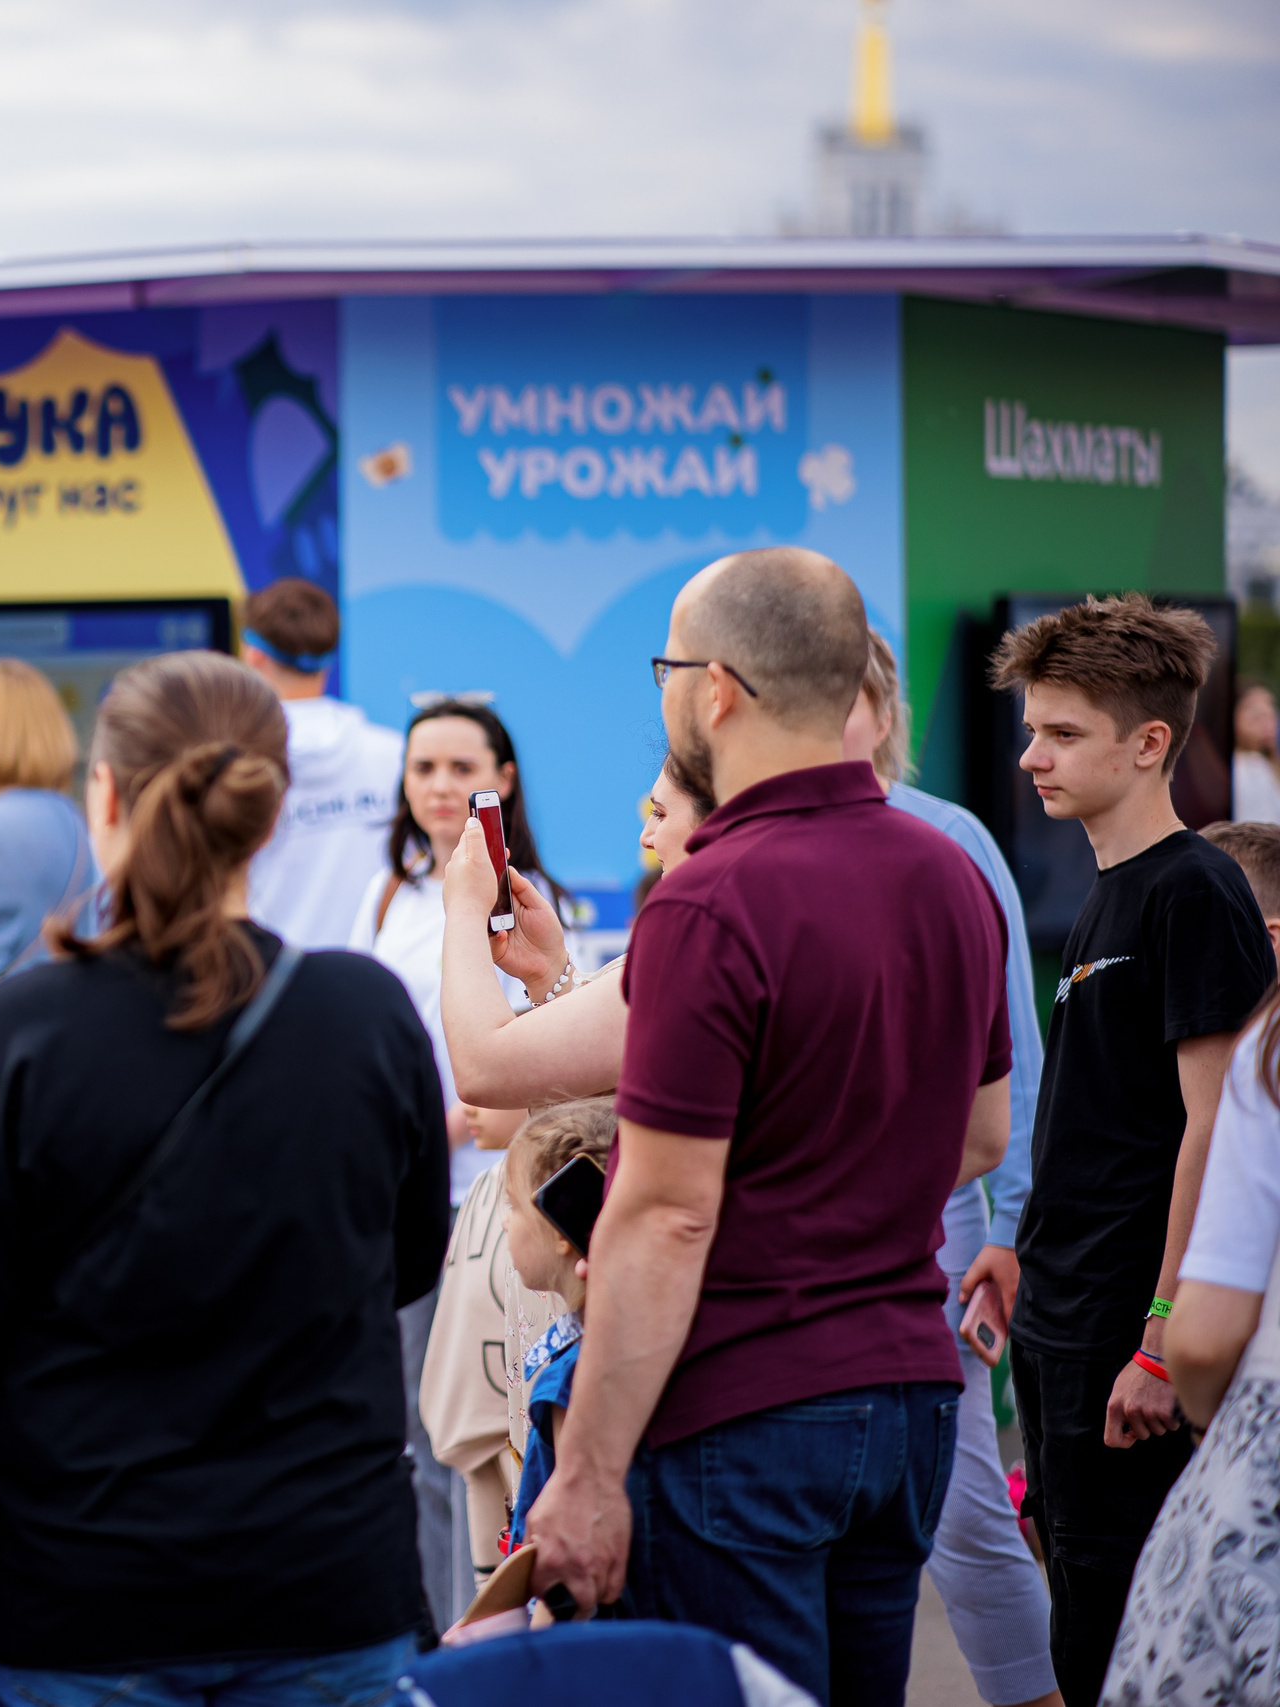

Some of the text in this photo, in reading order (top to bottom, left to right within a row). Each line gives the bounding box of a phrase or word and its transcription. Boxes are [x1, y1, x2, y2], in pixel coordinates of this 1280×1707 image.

[448, 370, 787, 436] УМНОЖАЙ
[477, 436, 760, 498] УРОЖАЙ
[984, 397, 1161, 489] Шахматы
[59, 478, 142, 518] нас
